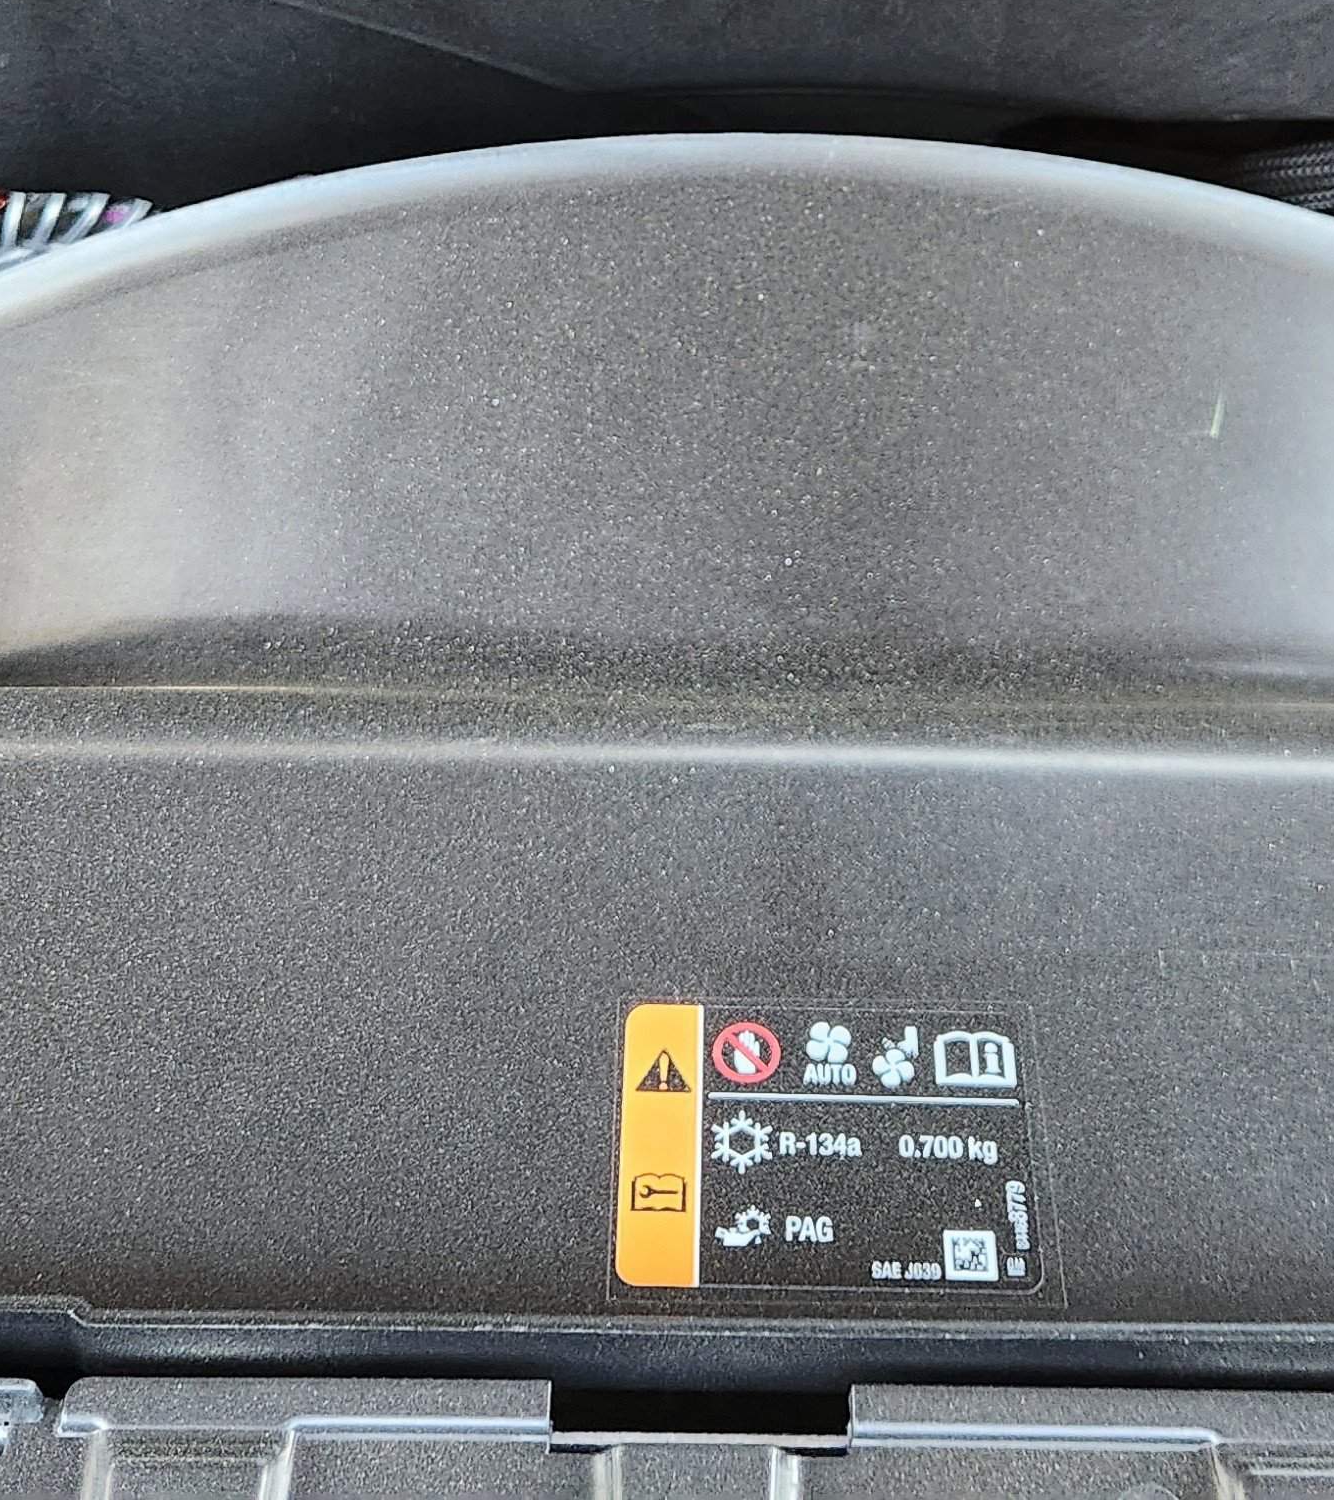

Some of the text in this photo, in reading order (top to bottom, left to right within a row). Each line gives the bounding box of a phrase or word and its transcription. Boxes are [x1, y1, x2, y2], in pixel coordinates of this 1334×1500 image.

[803, 1062, 857, 1087] AUTO
[778, 1130, 999, 1166] R-134a 0.700 kg
[784, 1214, 834, 1243] PAG
[871, 1260, 902, 1280] SAE
